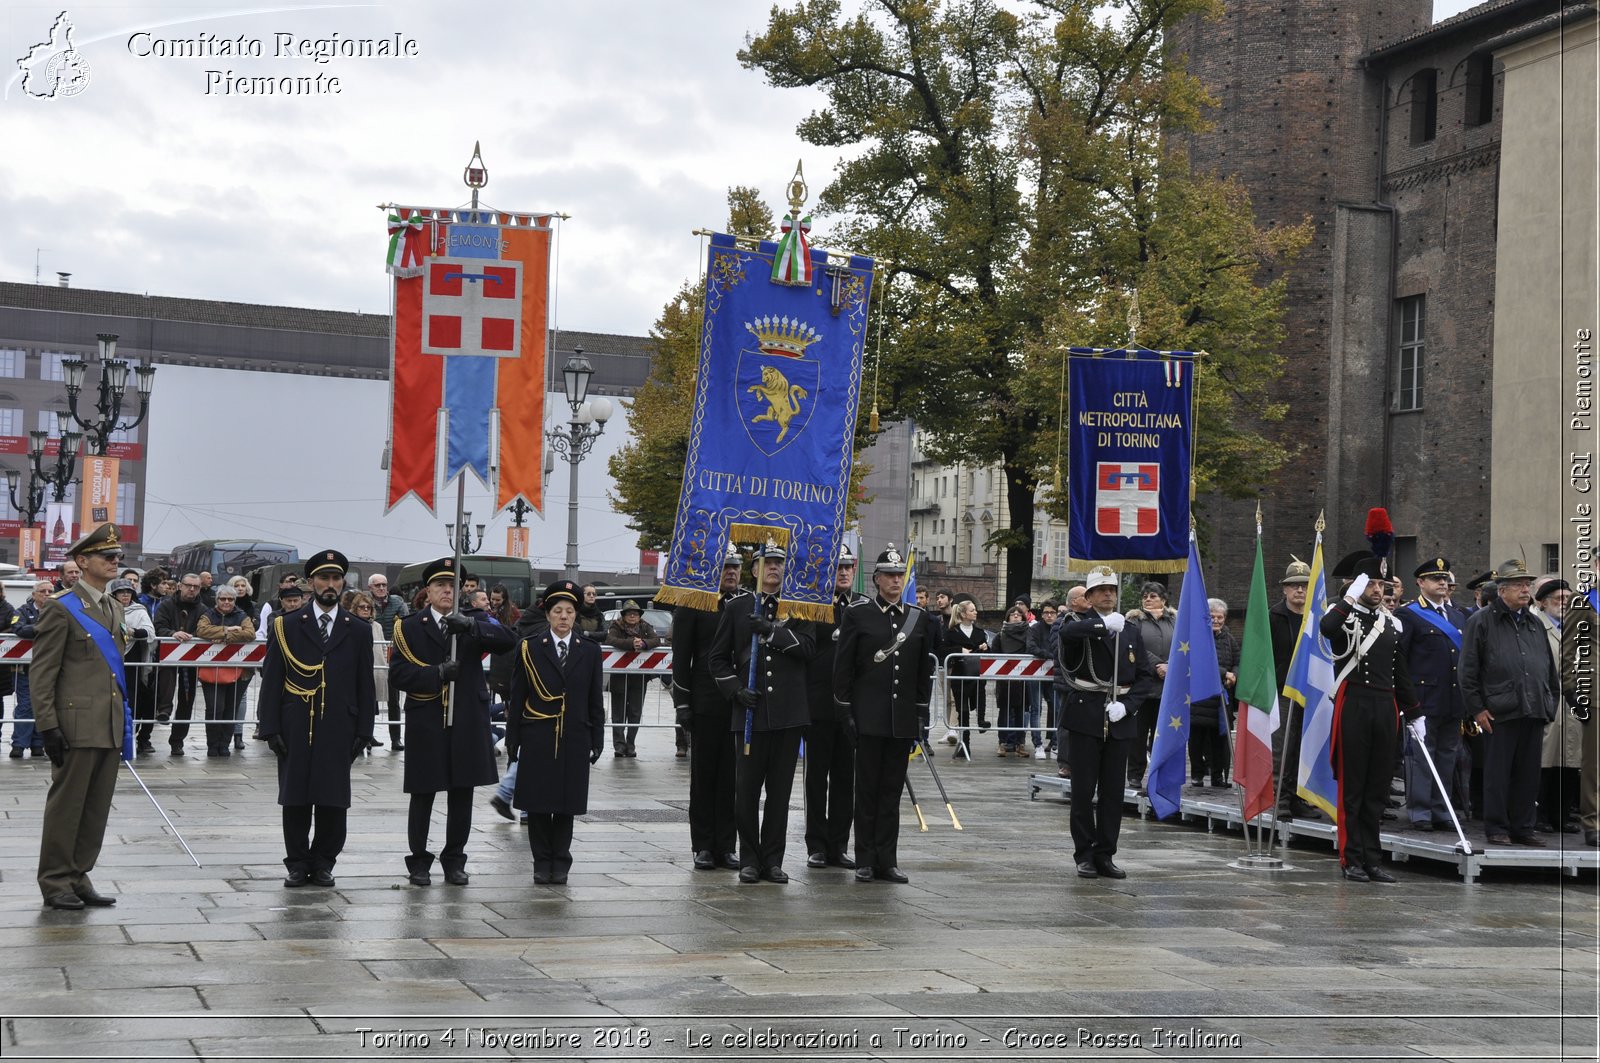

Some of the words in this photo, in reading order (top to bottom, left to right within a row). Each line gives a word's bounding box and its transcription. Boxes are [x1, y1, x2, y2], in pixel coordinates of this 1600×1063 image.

[438, 234, 510, 253] PIEMONTE
[1113, 390, 1148, 408] CITTÀ
[1079, 411, 1182, 428] METROPOLITANA
[1098, 432, 1111, 447] DI
[1115, 432, 1160, 449] TORINO
[700, 469, 746, 494] CITTA'
[750, 476, 768, 497] DI
[773, 478, 833, 505] TORINO
